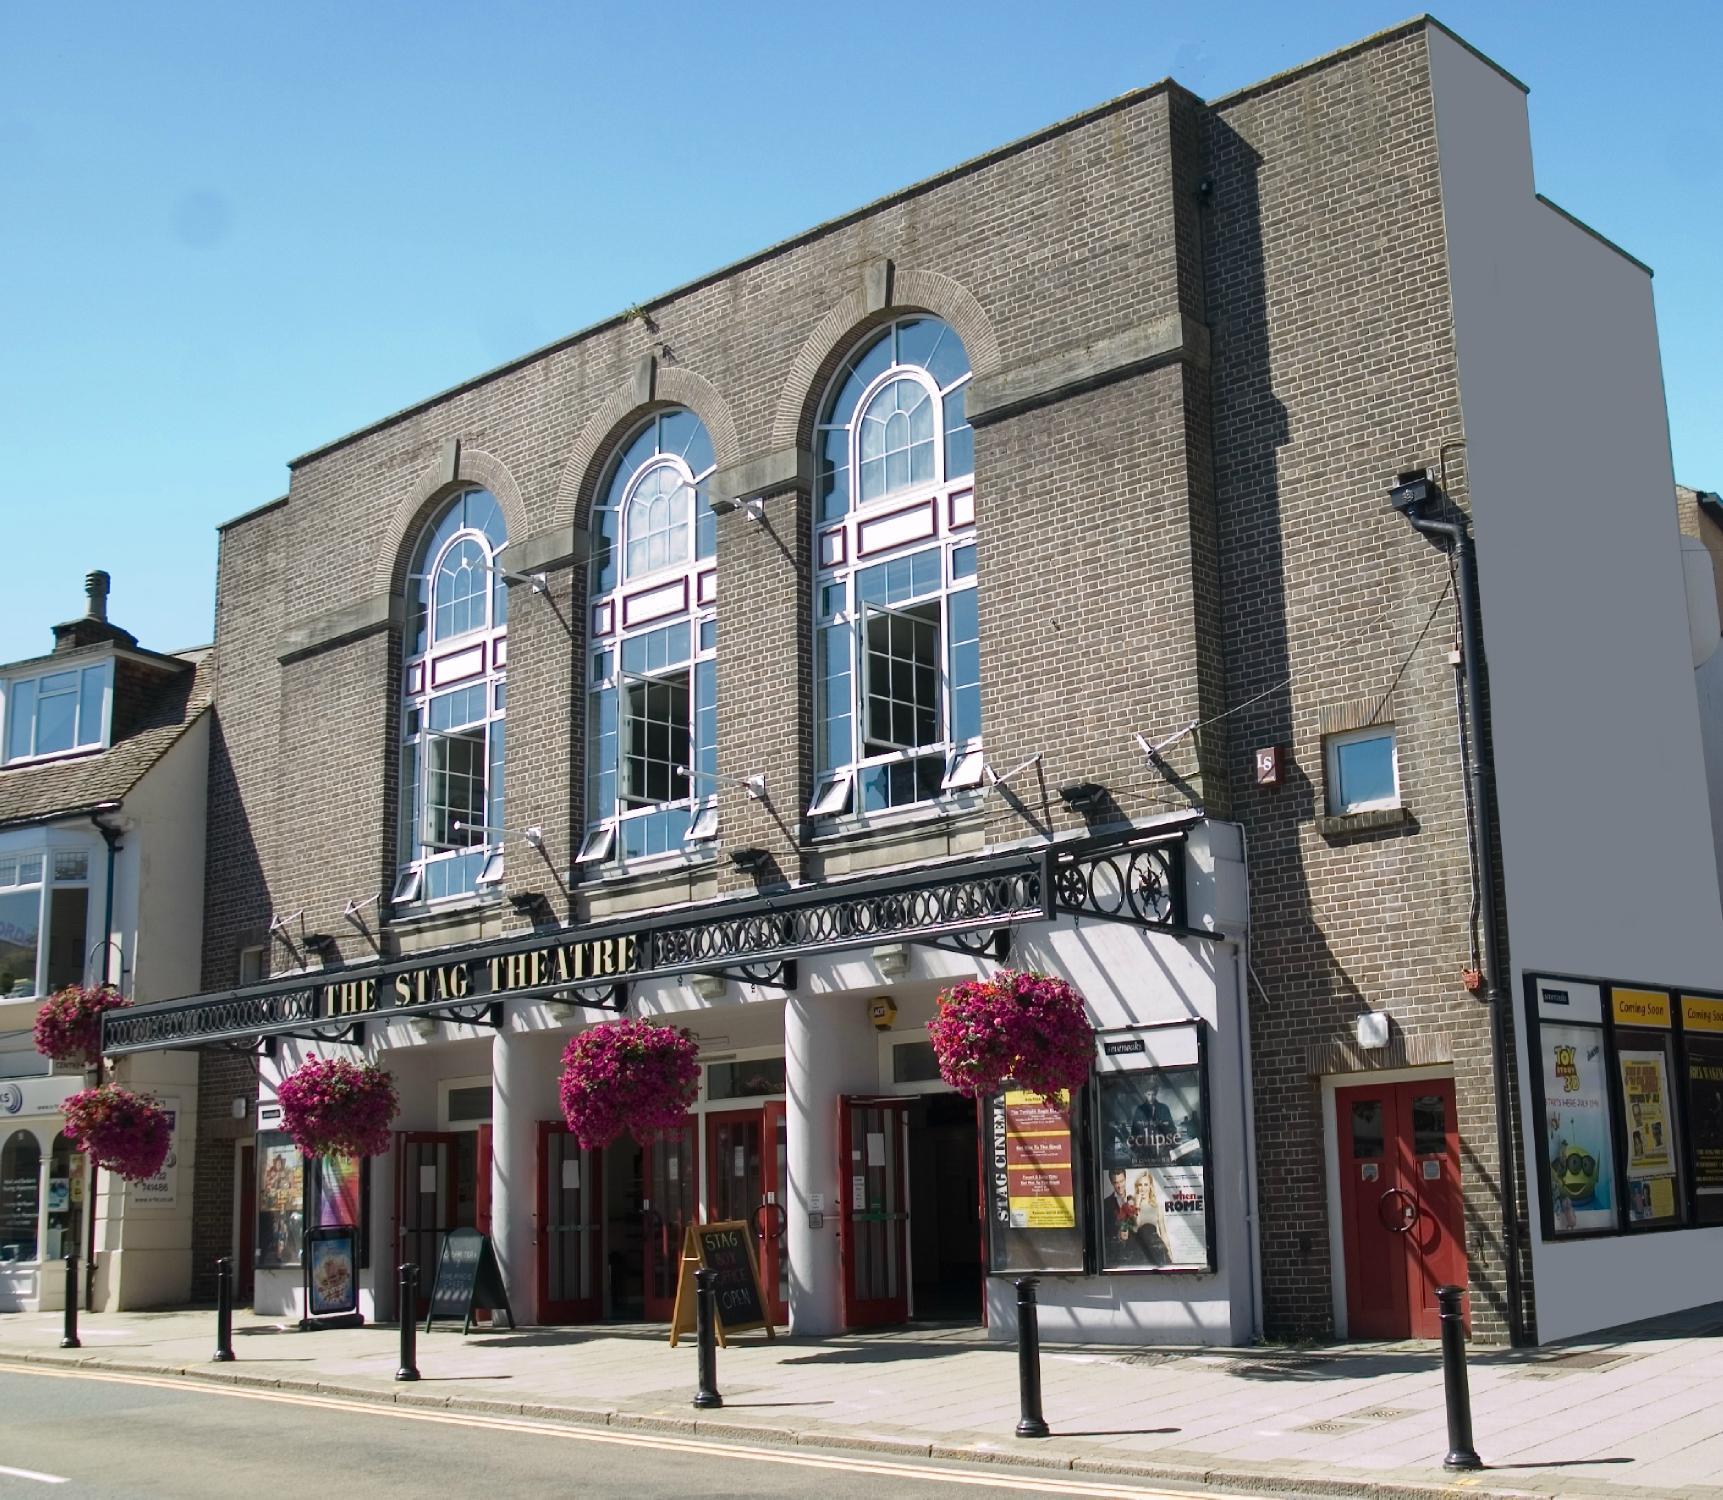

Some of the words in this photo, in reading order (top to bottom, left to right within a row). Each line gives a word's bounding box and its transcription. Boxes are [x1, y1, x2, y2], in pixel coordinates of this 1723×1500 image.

[324, 978, 376, 1017] THE
[395, 963, 471, 1006] STAG
[487, 934, 638, 992] THEATRE
[1619, 1000, 1646, 1016] Coming
[1647, 1003, 1665, 1015] Soon
[1687, 1007, 1711, 1023] Coming
[1554, 1045, 1577, 1066] TOY
[993, 1095, 1007, 1169] CINEMA
[1127, 1127, 1182, 1156] eclipse
[996, 1173, 1009, 1222] STAG
[1172, 1190, 1196, 1201] when
[1164, 1200, 1204, 1213] ROME
[705, 1231, 738, 1251] STAG
[722, 1287, 751, 1309] OPEN
